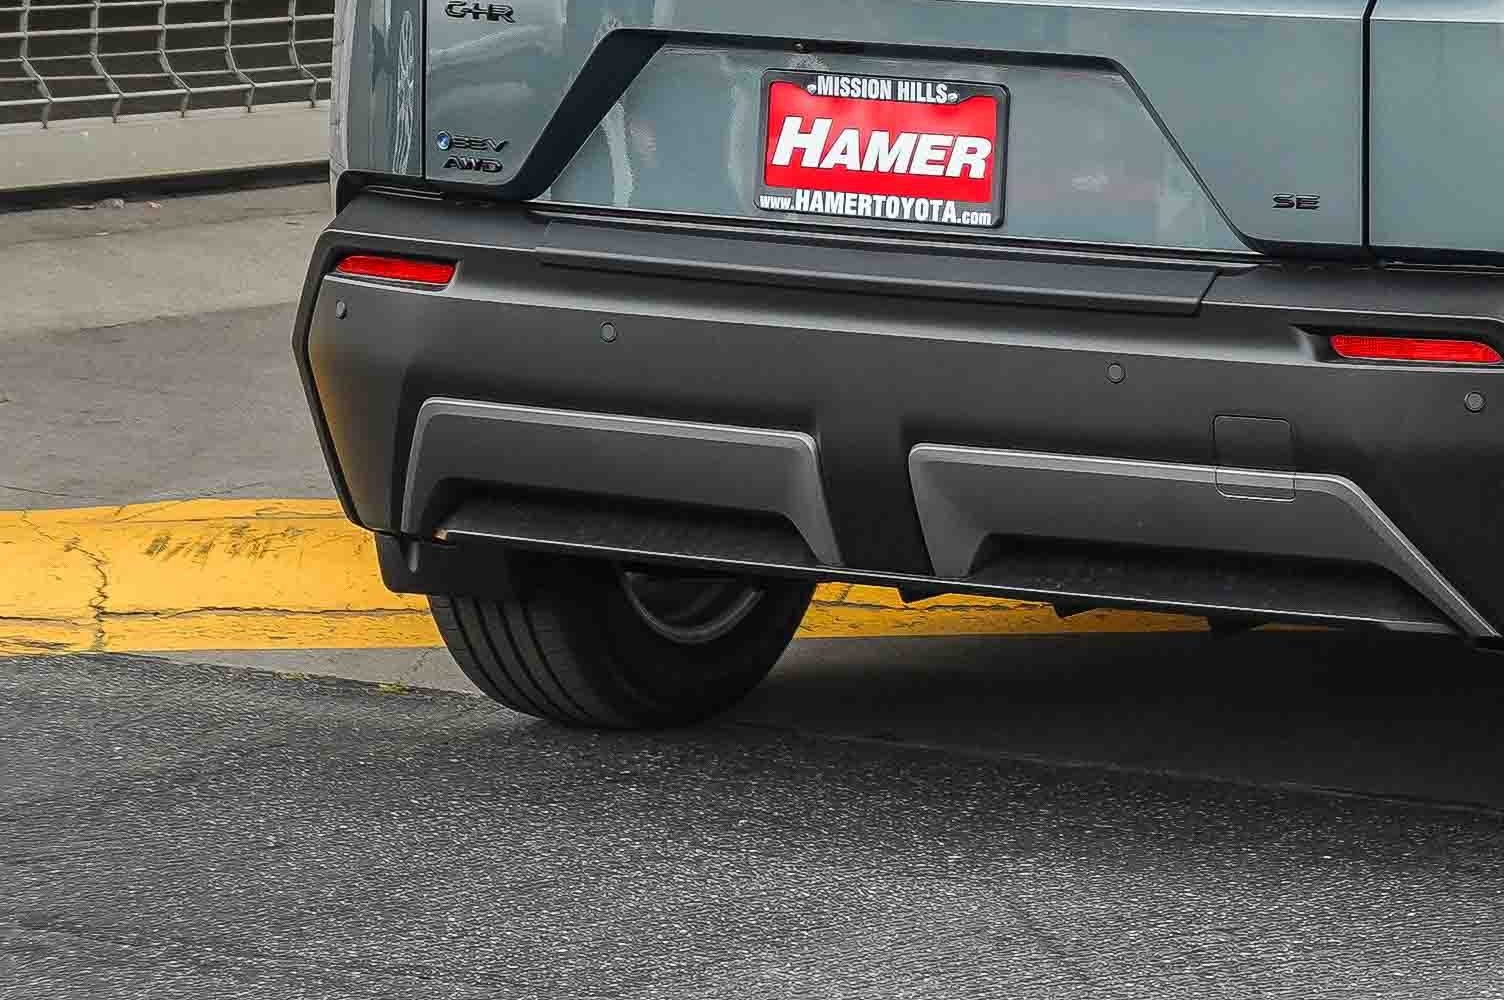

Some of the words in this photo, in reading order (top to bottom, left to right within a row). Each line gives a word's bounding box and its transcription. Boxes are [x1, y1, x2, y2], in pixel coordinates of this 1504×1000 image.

[816, 75, 892, 100] MISSION
[897, 80, 949, 104] HILLS
[771, 114, 992, 179] HAMER
[442, 155, 503, 173] AWD
[759, 189, 992, 226] www.HAMERTOYOTA.com
[1272, 193, 1320, 209] SE
